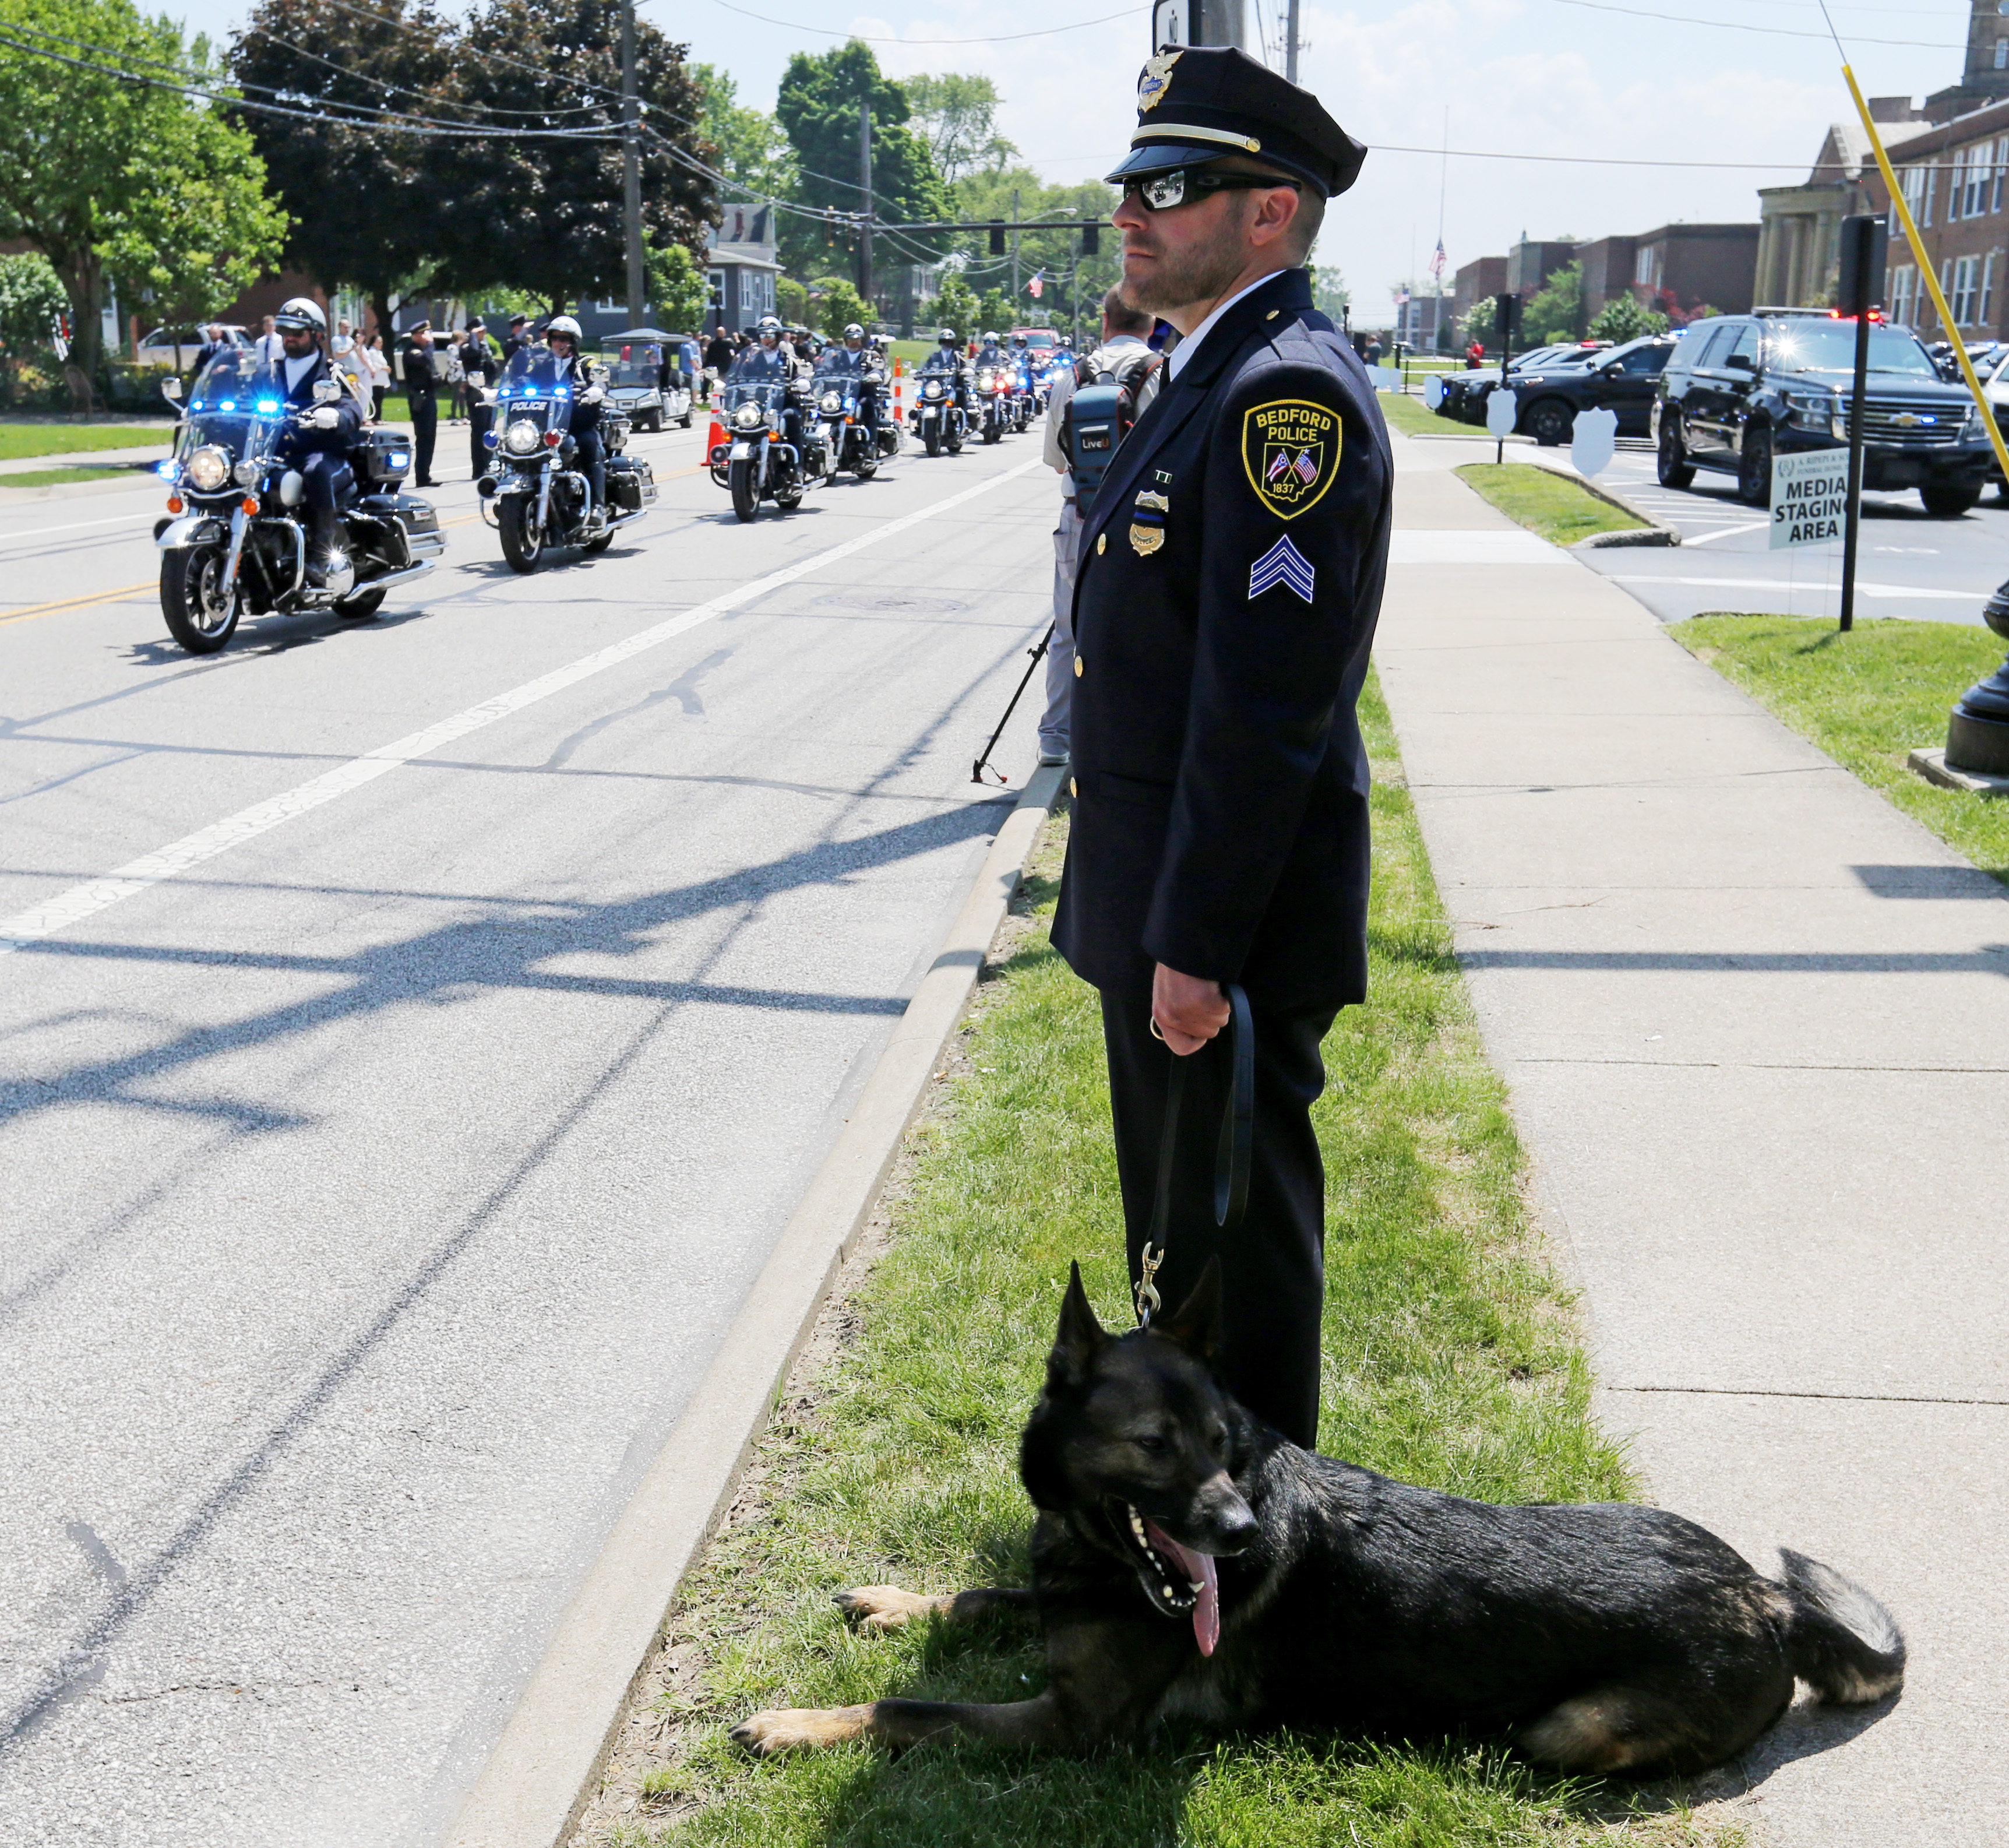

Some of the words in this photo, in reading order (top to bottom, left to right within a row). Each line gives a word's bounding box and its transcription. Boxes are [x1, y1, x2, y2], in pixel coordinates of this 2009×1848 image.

[510, 401, 548, 412] POLICE
[1256, 409, 1331, 430] BEDFORD
[1268, 427, 1317, 442] POLICE
[1273, 483, 1295, 493] 1837
[1786, 477, 1846, 499] MEDIA
[1775, 498, 1847, 523] STAGIN
[1789, 520, 1839, 542] AREA
